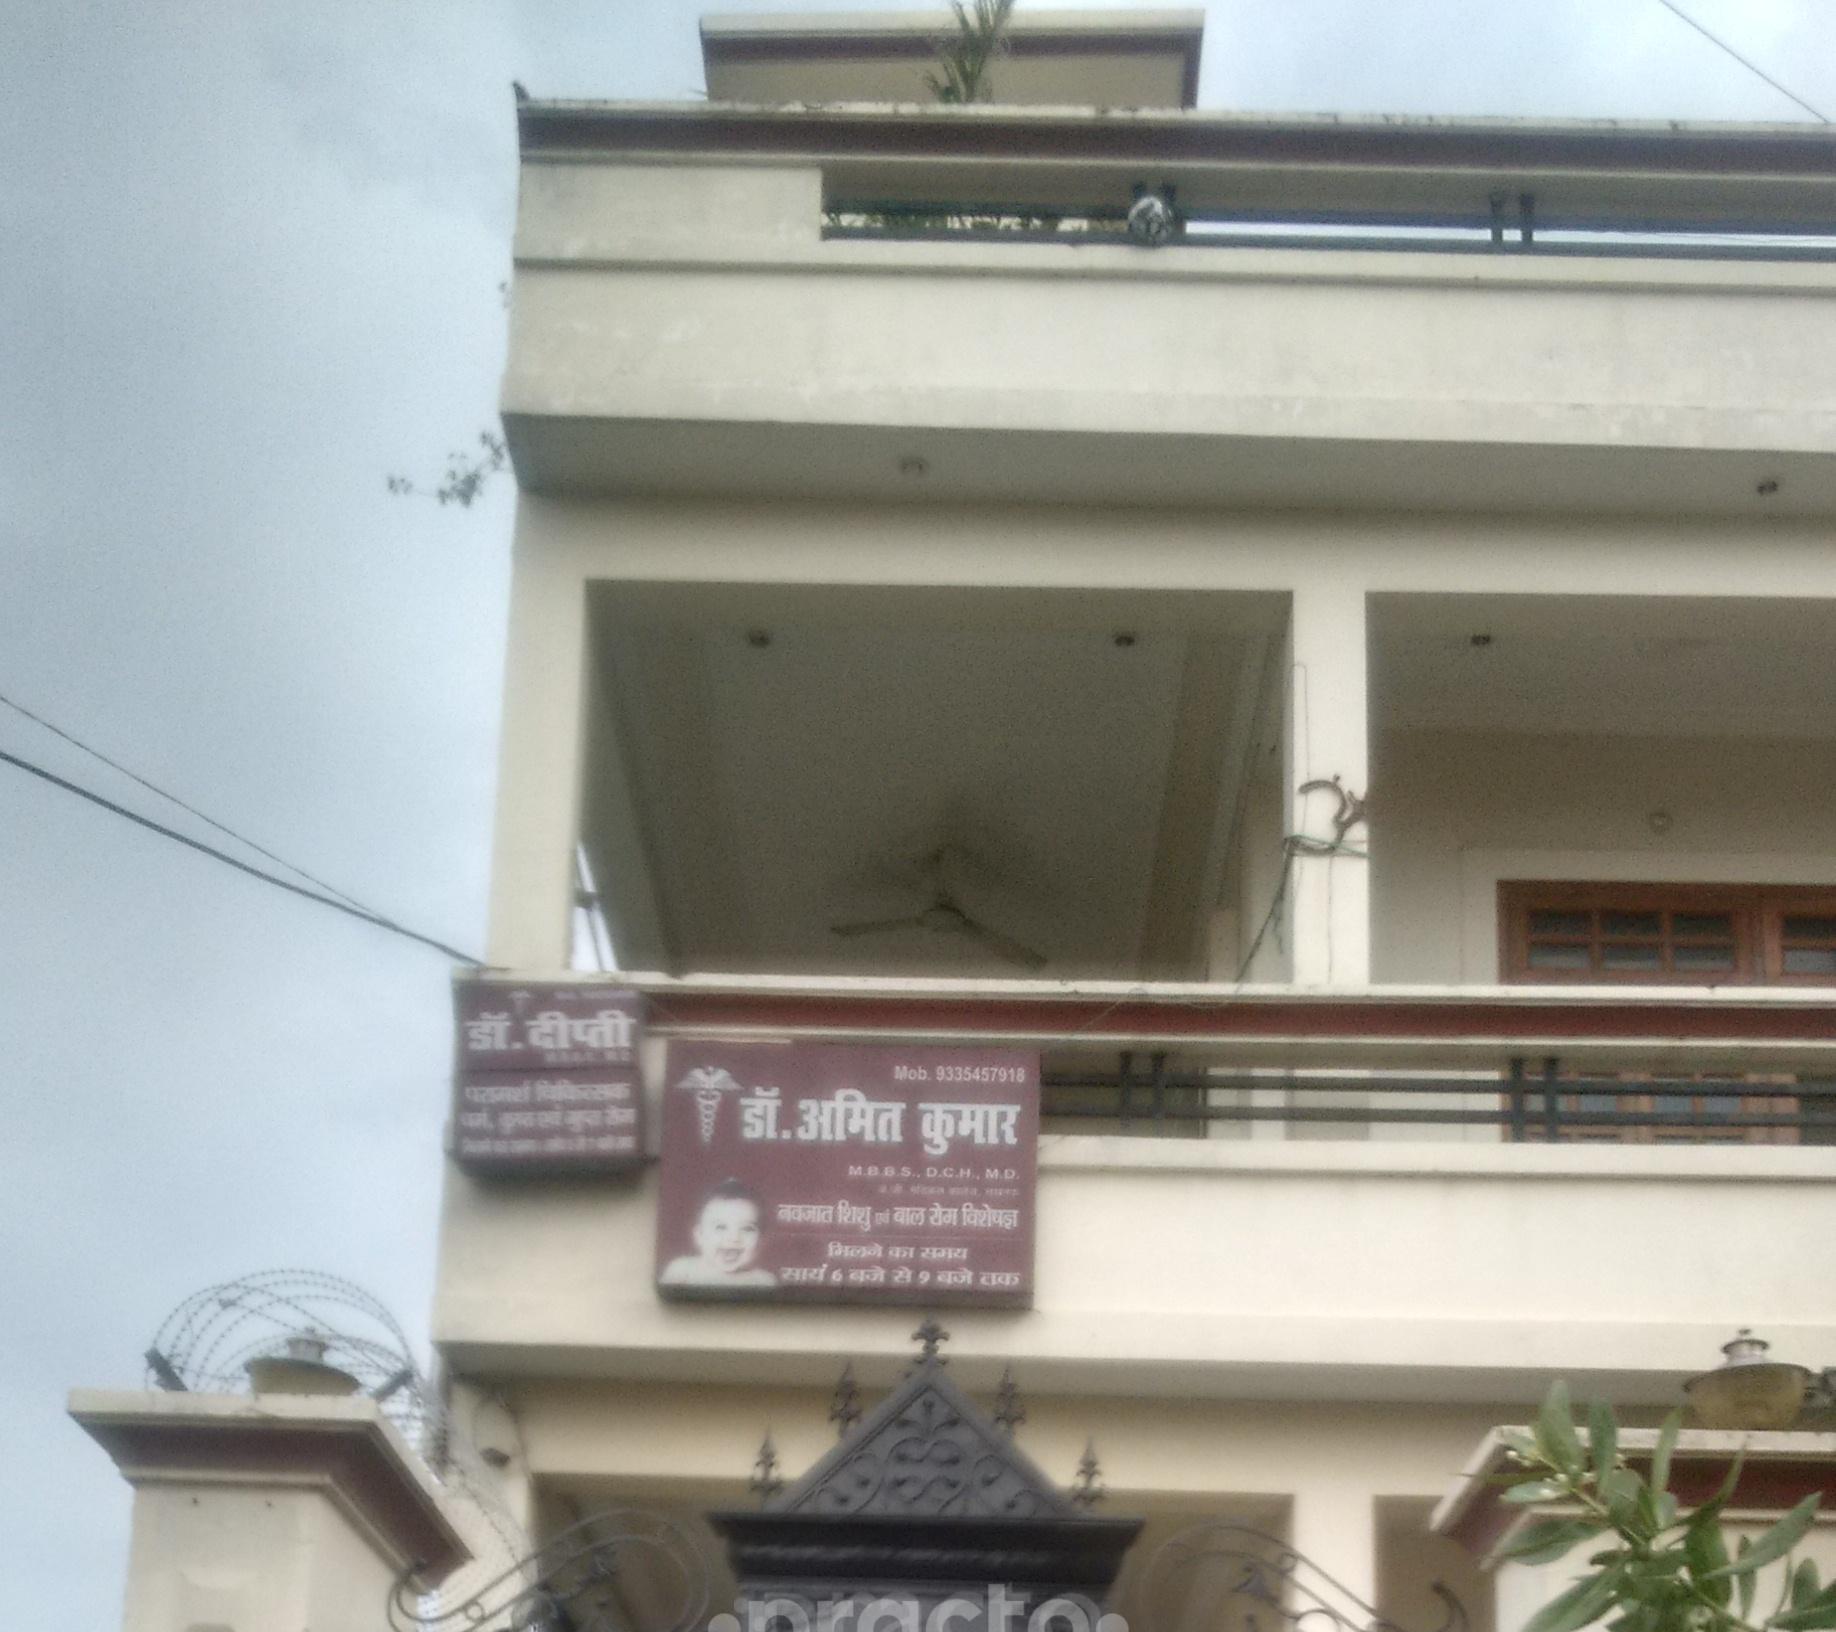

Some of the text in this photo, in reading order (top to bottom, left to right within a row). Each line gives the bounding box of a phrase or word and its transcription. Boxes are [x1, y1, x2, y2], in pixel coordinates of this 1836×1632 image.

[894, 1065, 1025, 1082] Mob. 9335457918
[917, 1102, 1021, 1155] कुमार
[778, 1203, 833, 1223] नवजात
[837, 1199, 872, 1232] शिशु
[893, 1207, 927, 1225] बाल
[929, 1202, 959, 1226] रोग
[828, 1241, 968, 1259] मिलने का समय
[780, 1263, 828, 1281] सायं
[832, 1268, 843, 1282] 6
[892, 1266, 912, 1283] से
[919, 1270, 930, 1284] 9
[980, 1271, 1021, 1286] तक
